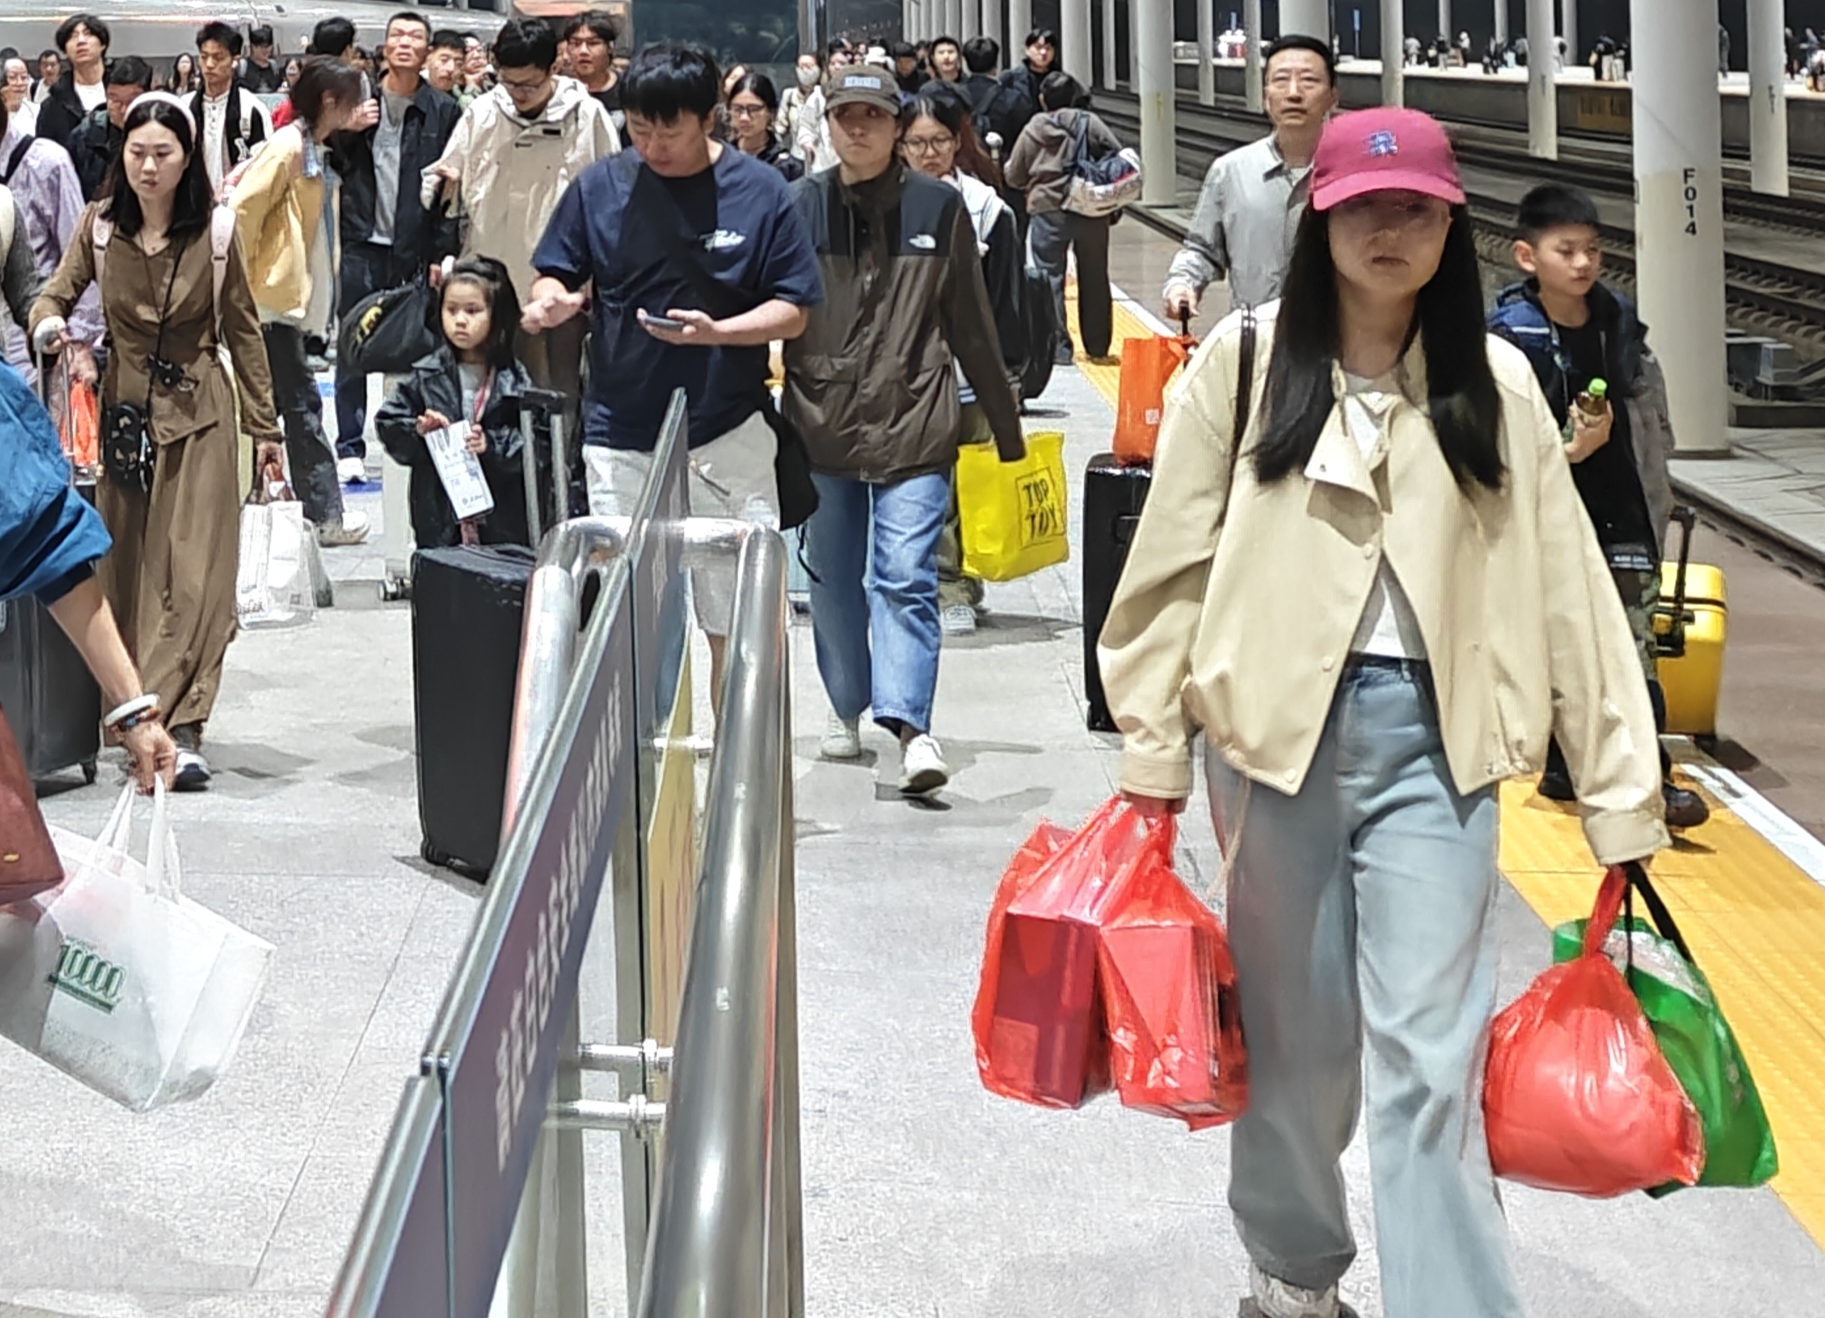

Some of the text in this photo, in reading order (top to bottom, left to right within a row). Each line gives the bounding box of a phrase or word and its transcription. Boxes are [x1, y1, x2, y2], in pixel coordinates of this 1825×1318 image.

[1683, 167, 1698, 236] F014
[1022, 478, 1050, 507] TOP
[1025, 502, 1059, 540] TOY
